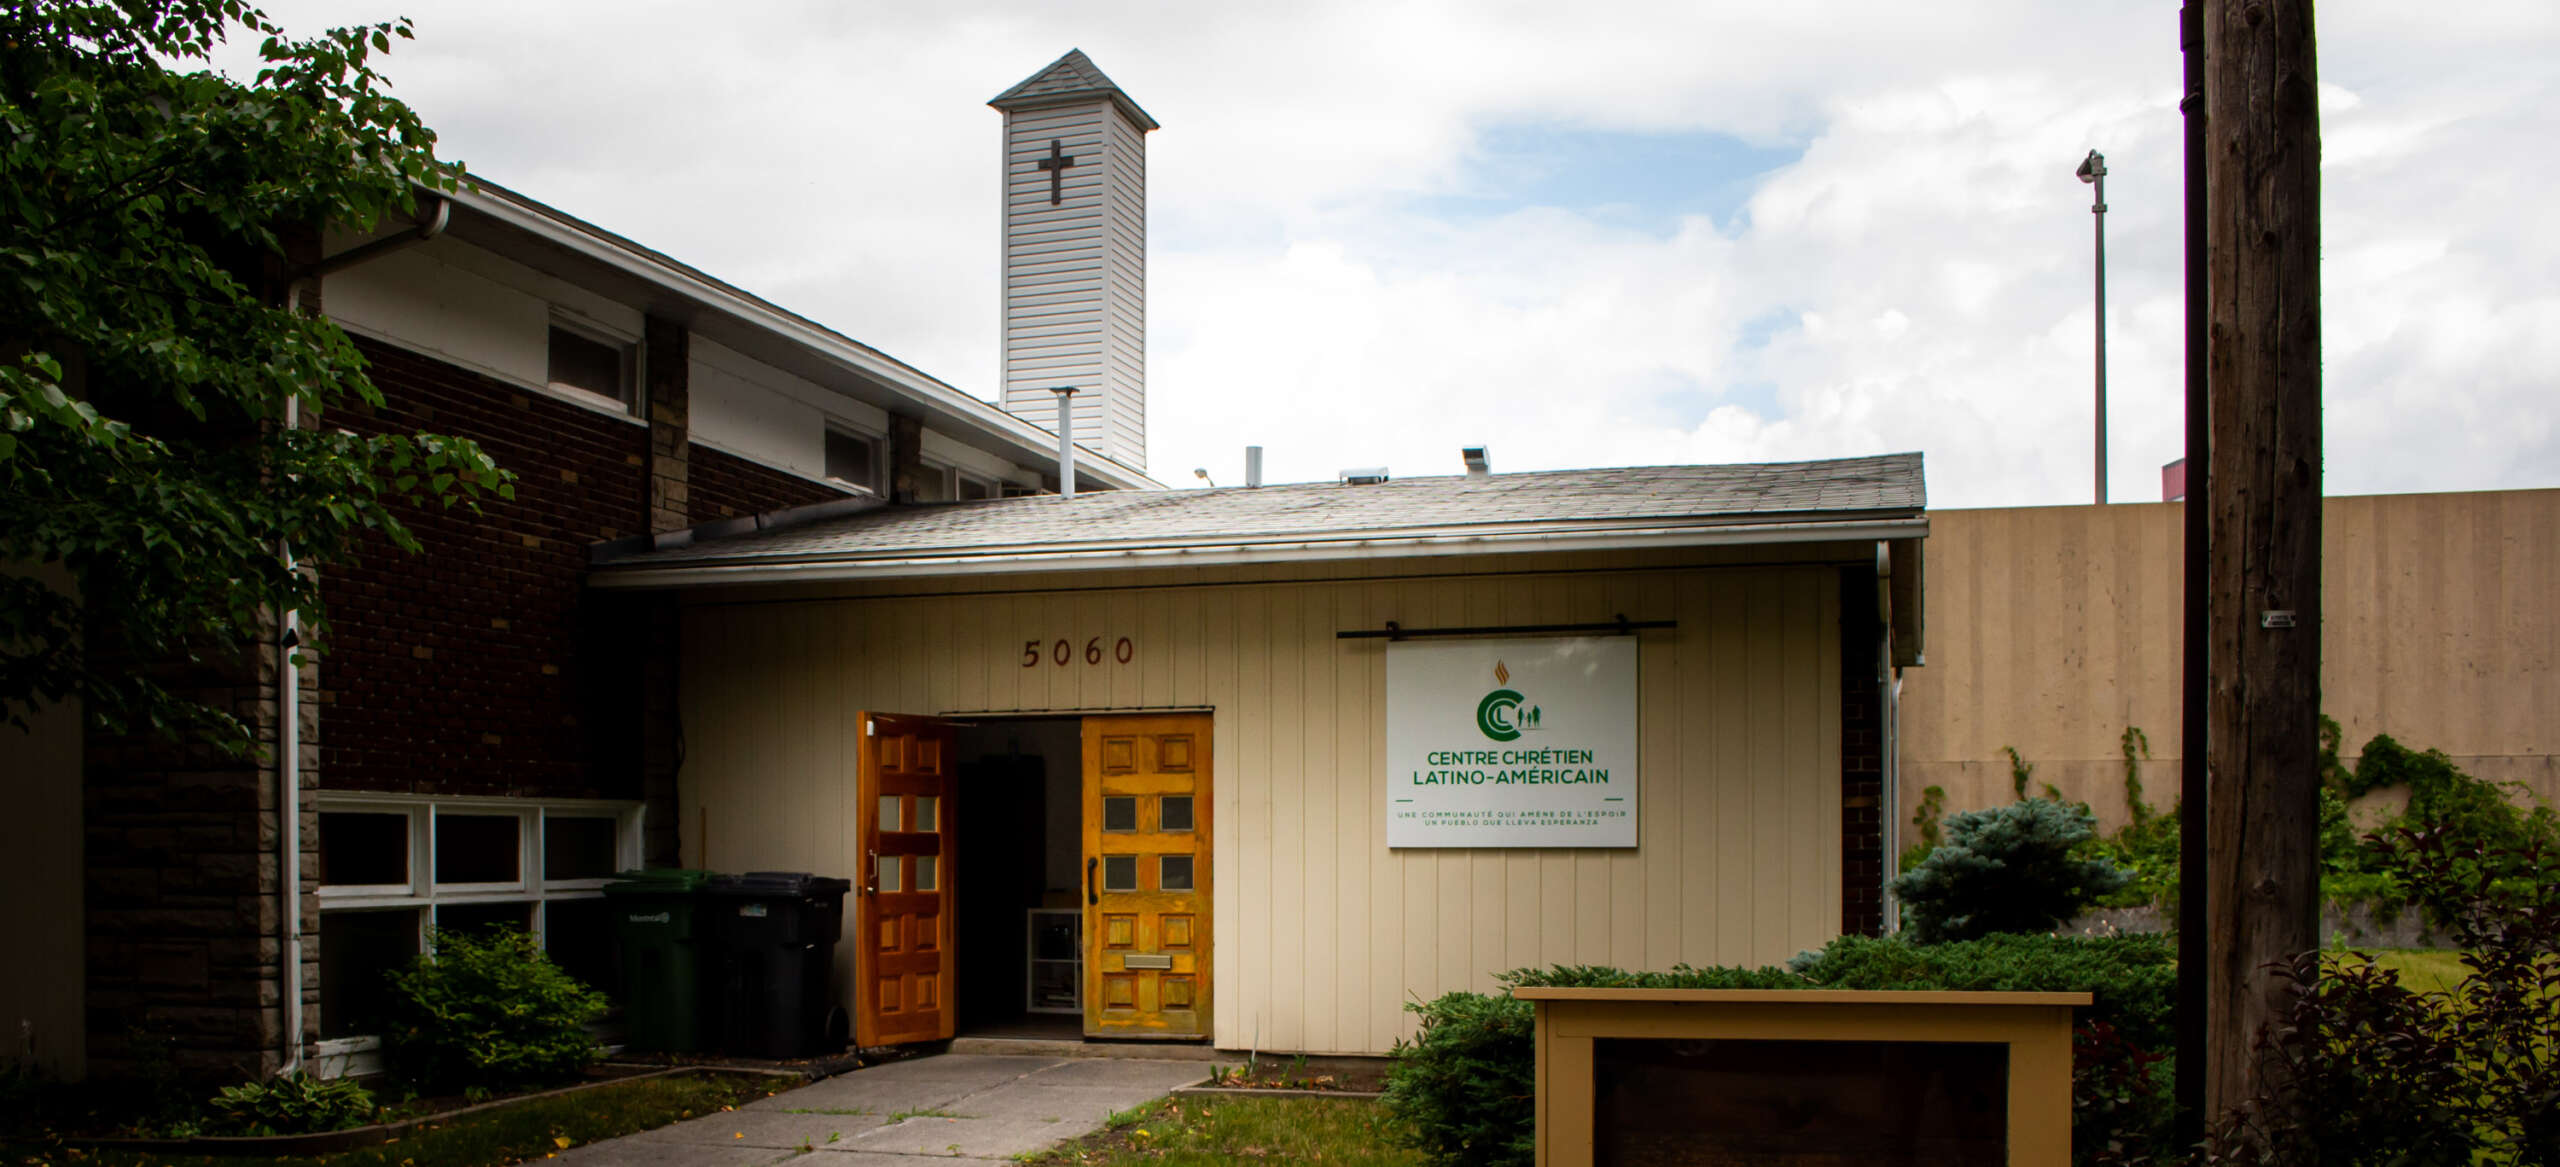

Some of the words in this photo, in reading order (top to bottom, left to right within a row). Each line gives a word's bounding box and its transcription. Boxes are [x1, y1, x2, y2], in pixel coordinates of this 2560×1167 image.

[1022, 636, 1132, 667] 5060
[1428, 751, 1498, 765] CENTRE
[1502, 746, 1592, 764] CHRÉTIEN
[1413, 767, 1608, 785] LATINO-AMÉRICAIN
[1397, 810, 1416, 818] UNE
[1498, 810, 1515, 818] QUI
[1560, 810, 1572, 818] DE
